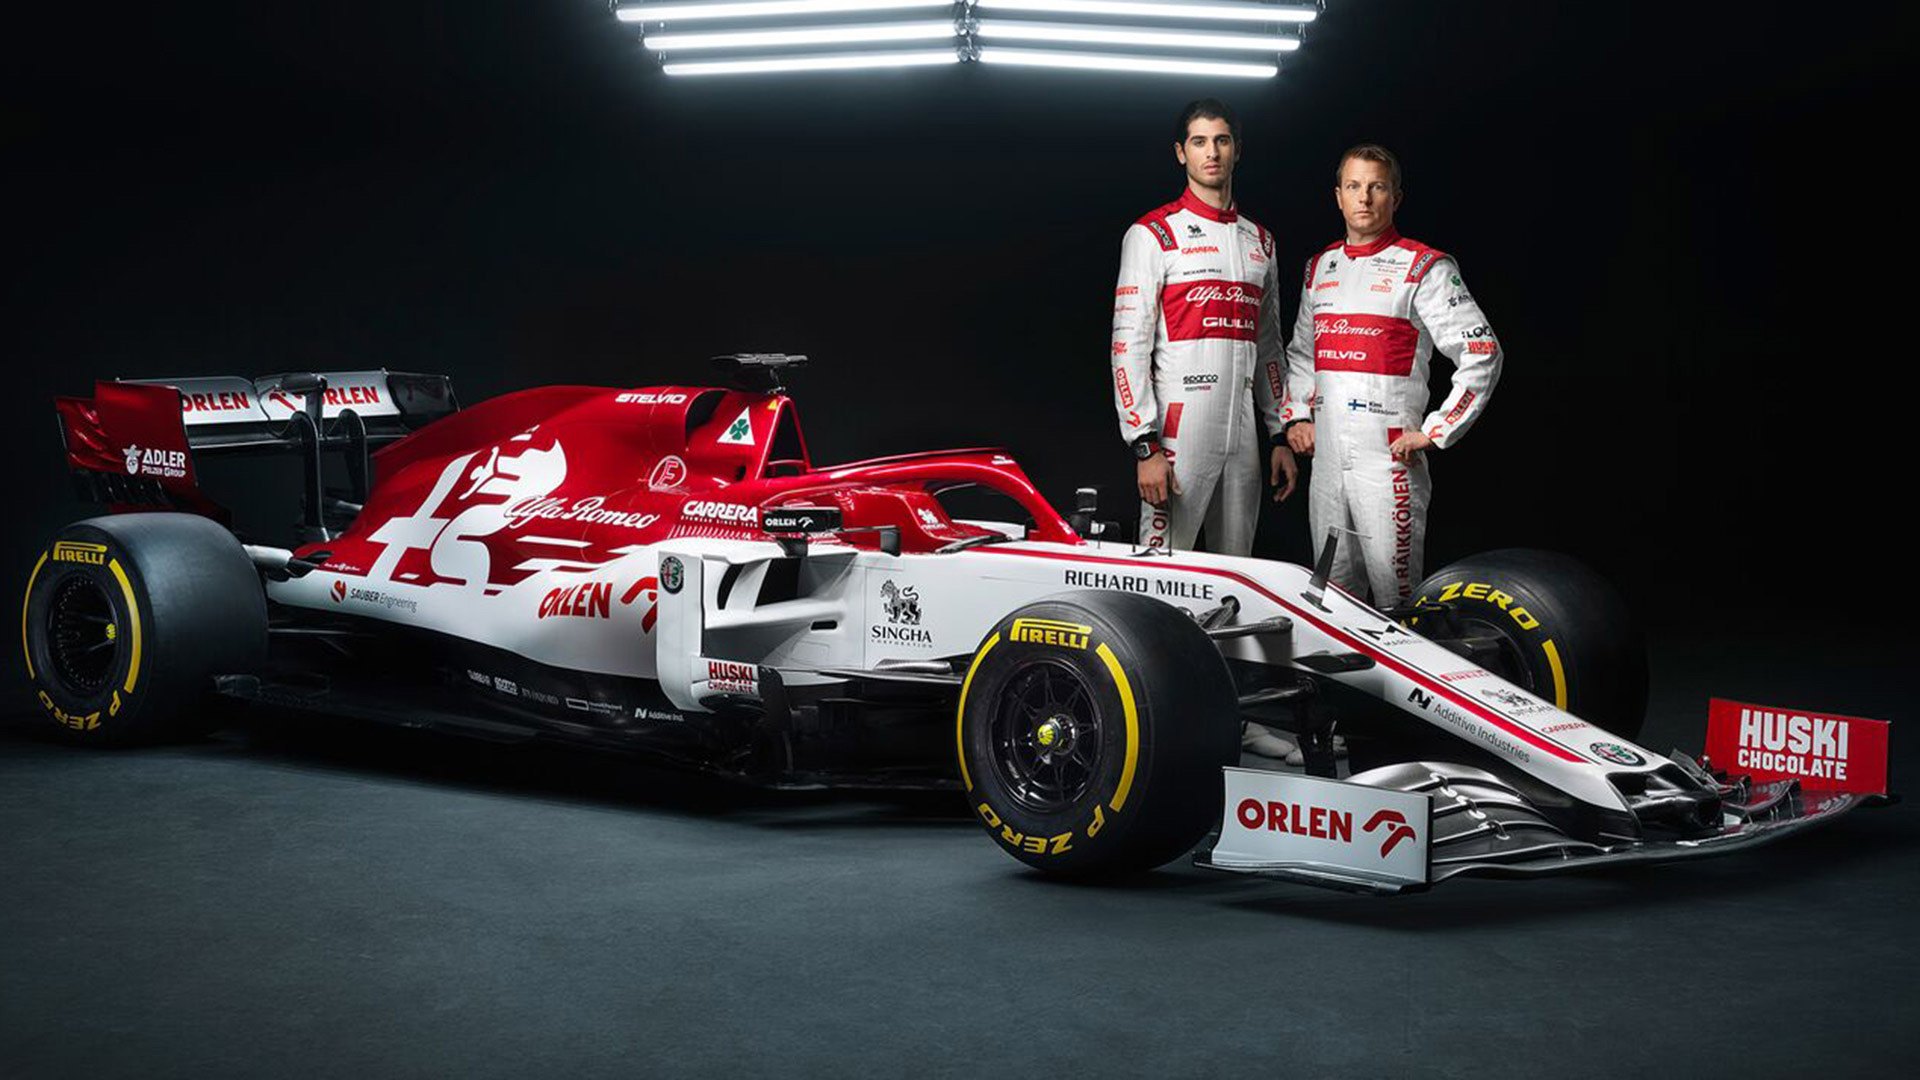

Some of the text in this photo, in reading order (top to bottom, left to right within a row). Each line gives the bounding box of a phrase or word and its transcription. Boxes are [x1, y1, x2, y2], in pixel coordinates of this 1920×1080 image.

[1186, 286, 1224, 307] Alfa
[1203, 317, 1254, 330] GIULIA
[1332, 318, 1385, 336] Romeo
[1318, 349, 1366, 360] STELVIO
[1116, 368, 1132, 406] ORLEN
[1183, 374, 1219, 384] sparco
[615, 393, 687, 404] STELVIO
[142, 448, 185, 468] ADLER
[504, 495, 660, 529] Alfa Romeo
[683, 501, 758, 522] CARRERA
[765, 518, 796, 527] ORLEN
[1391, 469, 1412, 579] RÄIKKÖNEN
[53, 541, 107, 565] PIRELLI
[1064, 569, 1214, 600] RICHARD MILLE
[350, 588, 417, 614] SAUBER Engineering
[538, 582, 613, 619] ORLEN
[1438, 581, 1540, 631] ZERO
[871, 625, 932, 643] SINGHA
[1010, 617, 1093, 649] PIRELLI
[709, 661, 753, 684] HUSKI
[708, 680, 753, 694] CHOCOLATE
[39, 690, 121, 730] P ZERO
[1433, 704, 1530, 763] Additive Industries
[1739, 708, 1849, 760] HUSKI
[1738, 749, 1847, 780] CHOCOLATE
[978, 802, 1105, 854] P ZERO
[1237, 798, 1352, 843] ORLEN
